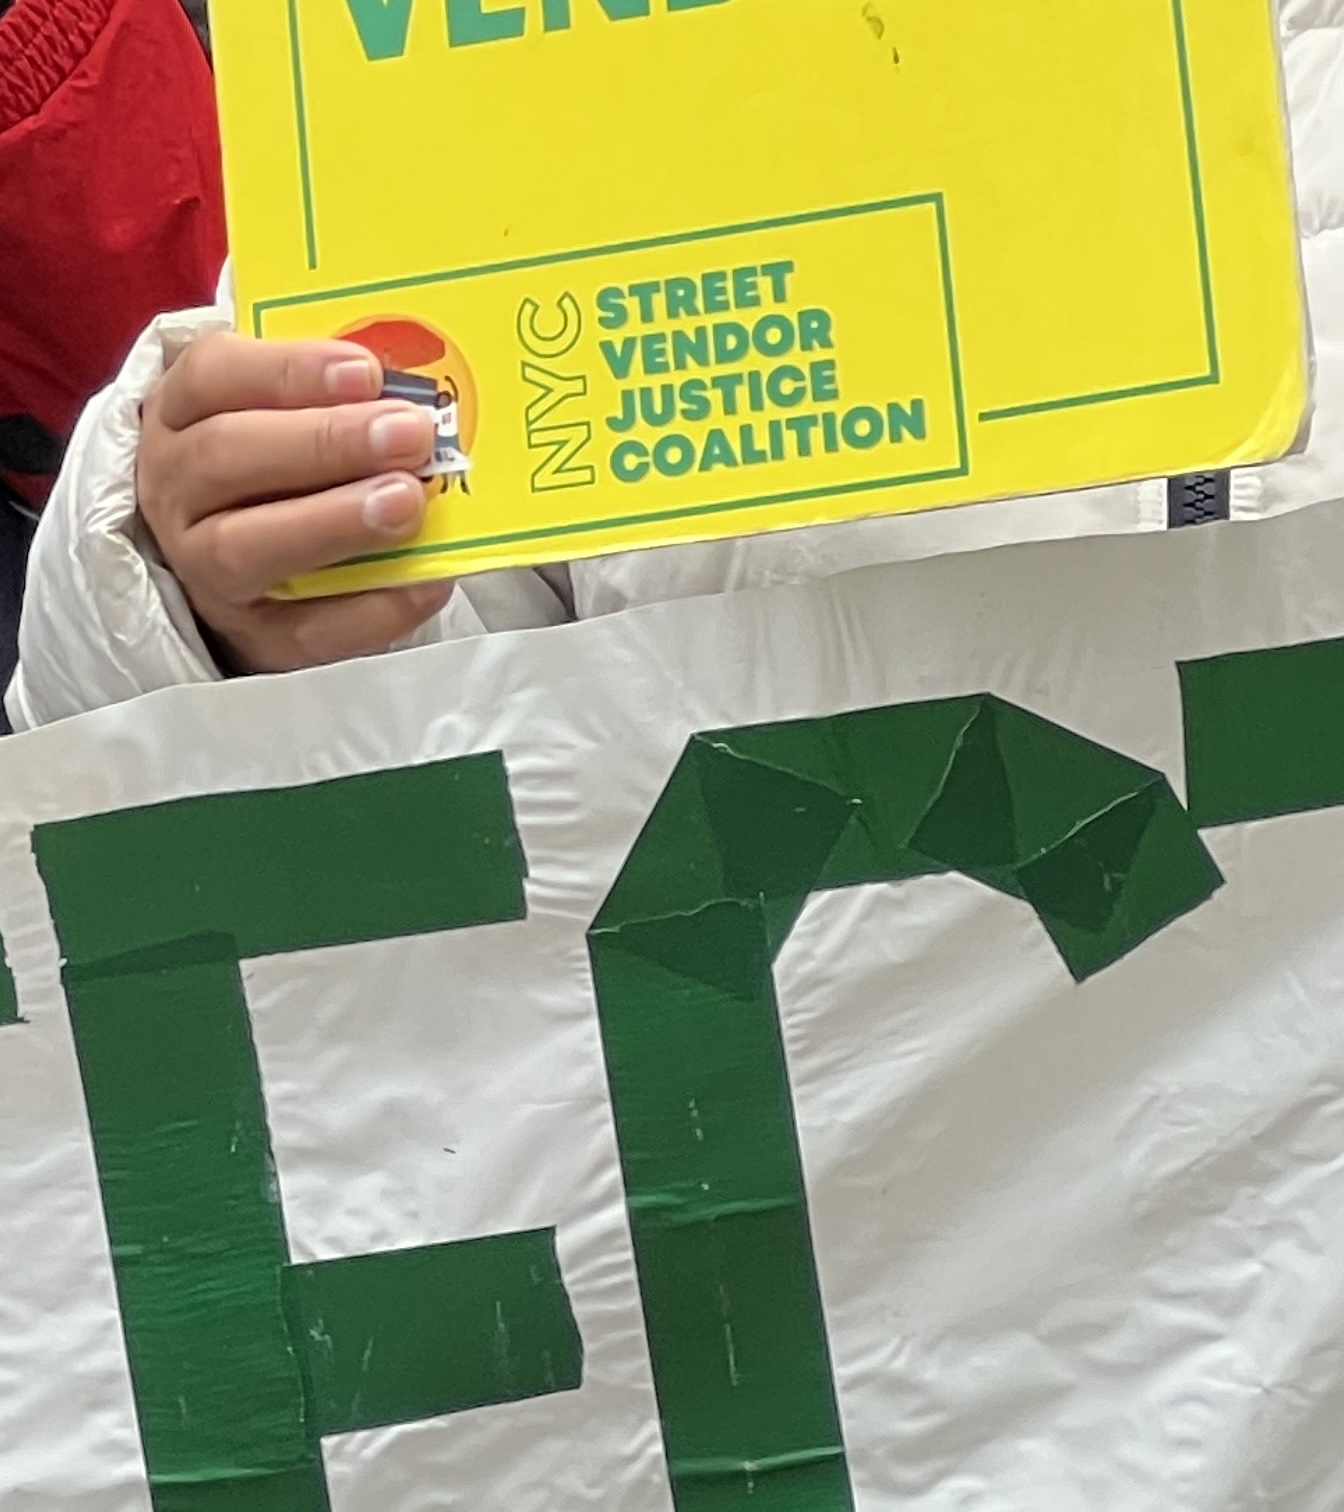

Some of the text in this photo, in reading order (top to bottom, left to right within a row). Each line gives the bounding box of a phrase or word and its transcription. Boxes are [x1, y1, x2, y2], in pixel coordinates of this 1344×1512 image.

[596, 260, 795, 330] STREET
[599, 309, 834, 380] VENDOR
[516, 290, 595, 494] NYC
[605, 360, 840, 433] JUSTICE
[610, 399, 927, 484] COALITION
